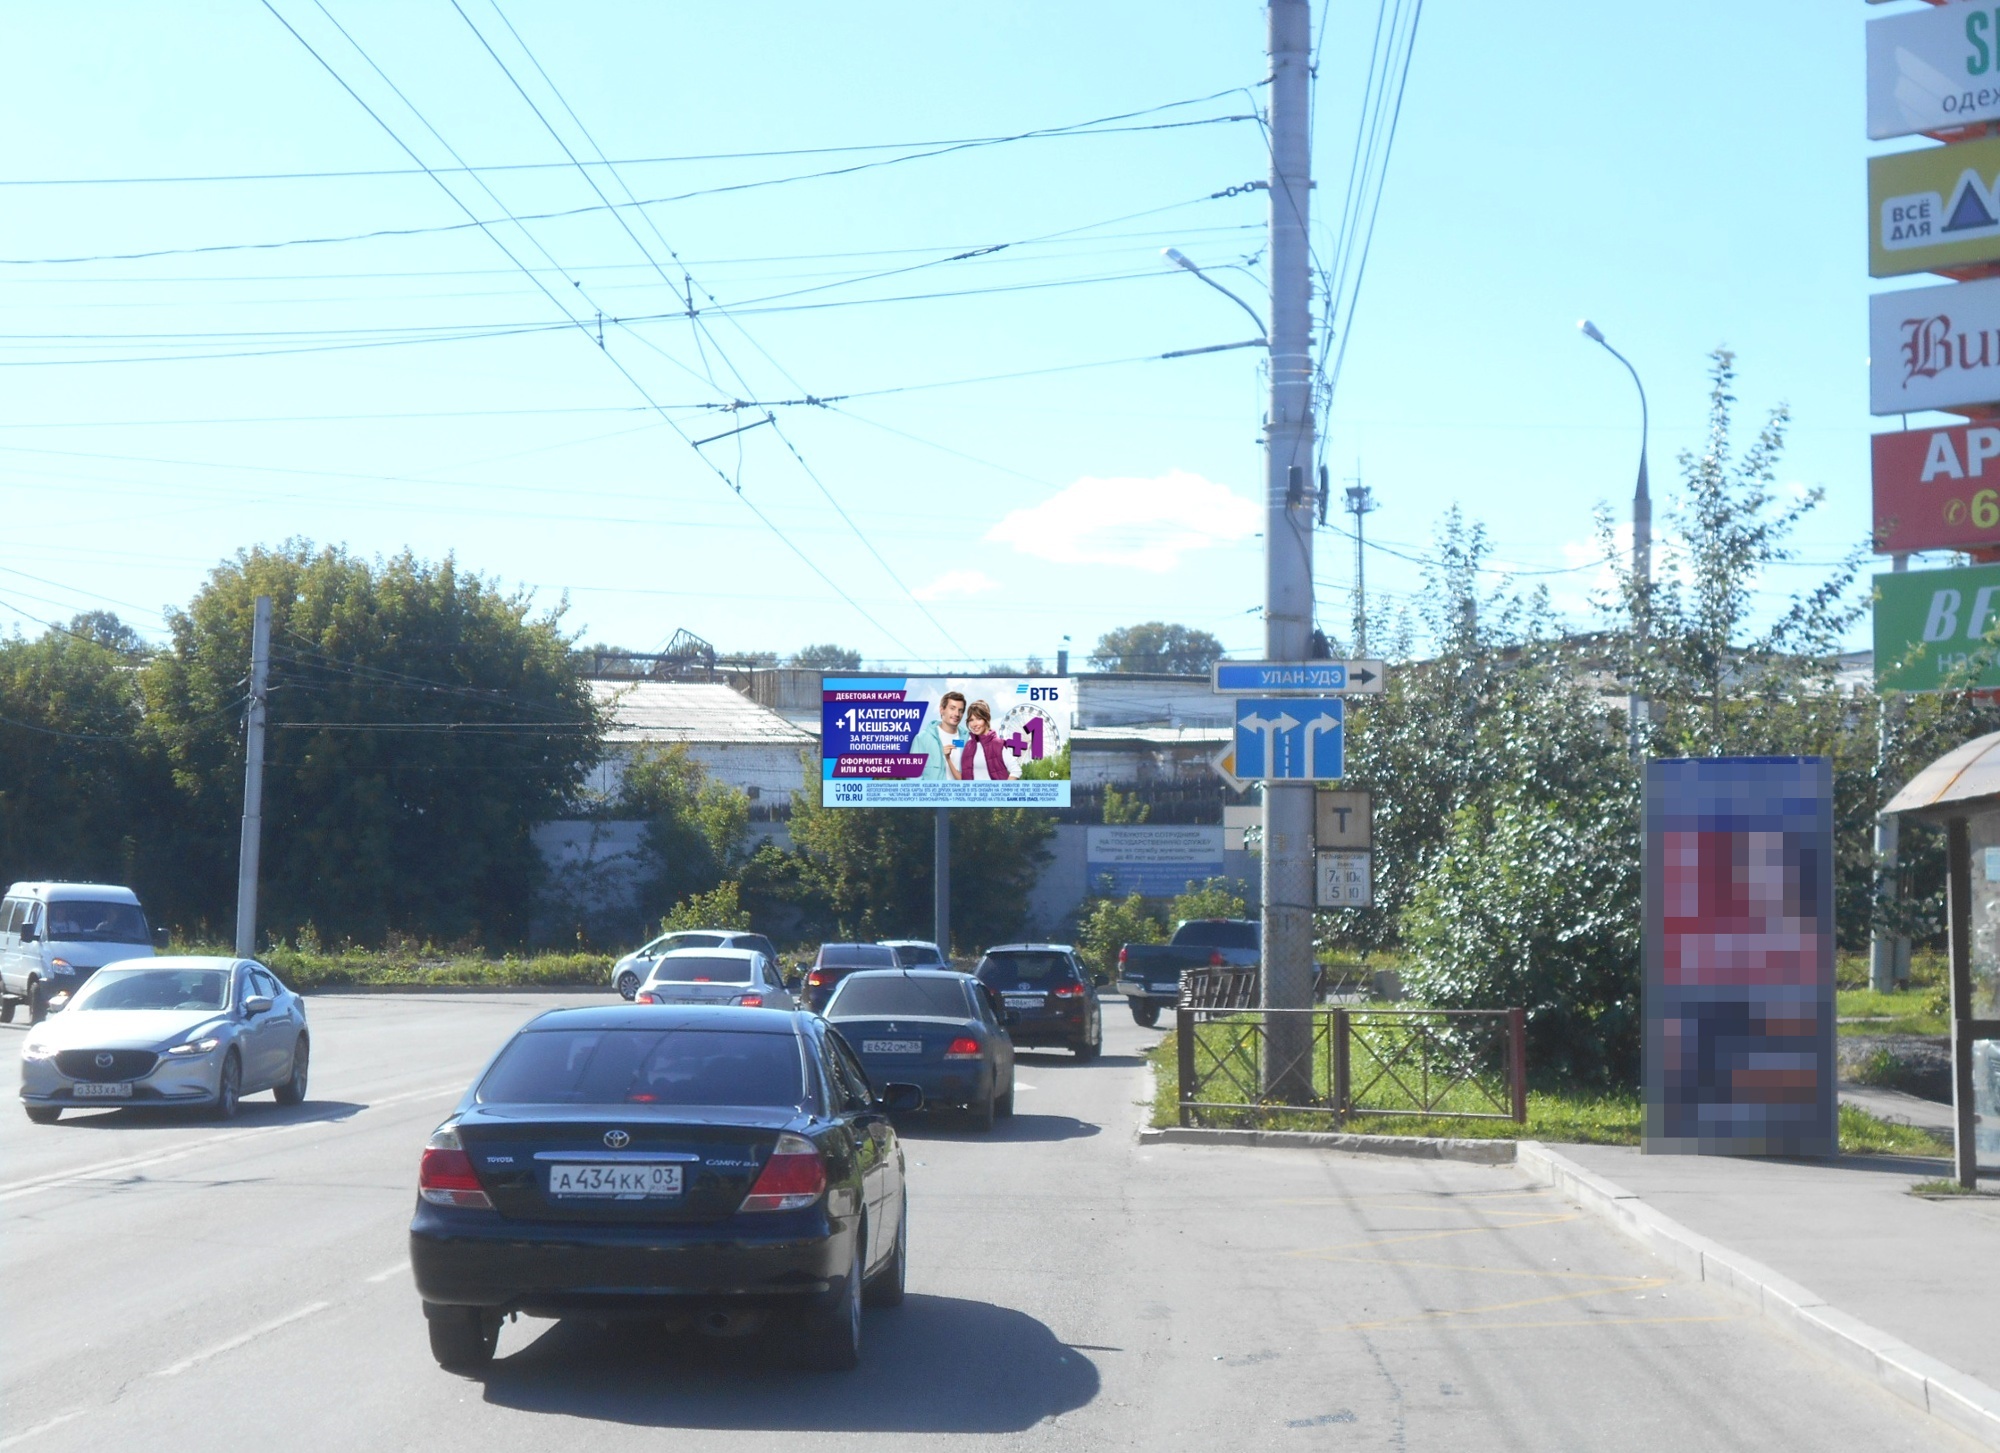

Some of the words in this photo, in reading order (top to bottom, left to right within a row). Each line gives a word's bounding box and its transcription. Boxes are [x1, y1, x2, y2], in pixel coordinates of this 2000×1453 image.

[1893, 199, 1931, 223] ВСЁ
[1261, 670, 1342, 686] УЛАН-УДЭ
[835, 692, 877, 701] ДЕБЕТОВАЯ
[878, 692, 901, 700] КАРТА
[1030, 687, 1059, 701] ВТБ
[858, 708, 920, 719] КАТЕГОРИЯ
[835, 708, 856, 732] +1
[858, 722, 912, 732] КЕШБЭКА
[849, 734, 860, 742] ЗА
[861, 734, 909, 742] РЕГУЛЯРНОЕ
[849, 743, 900, 751] ПОПОЛНЕНИЕ
[840, 757, 883, 765] ОФОРМИТЕ
[884, 757, 895, 765] НА
[897, 757, 923, 765] VTB.RU
[842, 783, 863, 792] 1000
[836, 793, 863, 801] VTB.RU
[705, 1159, 741, 1167] CAMRY
